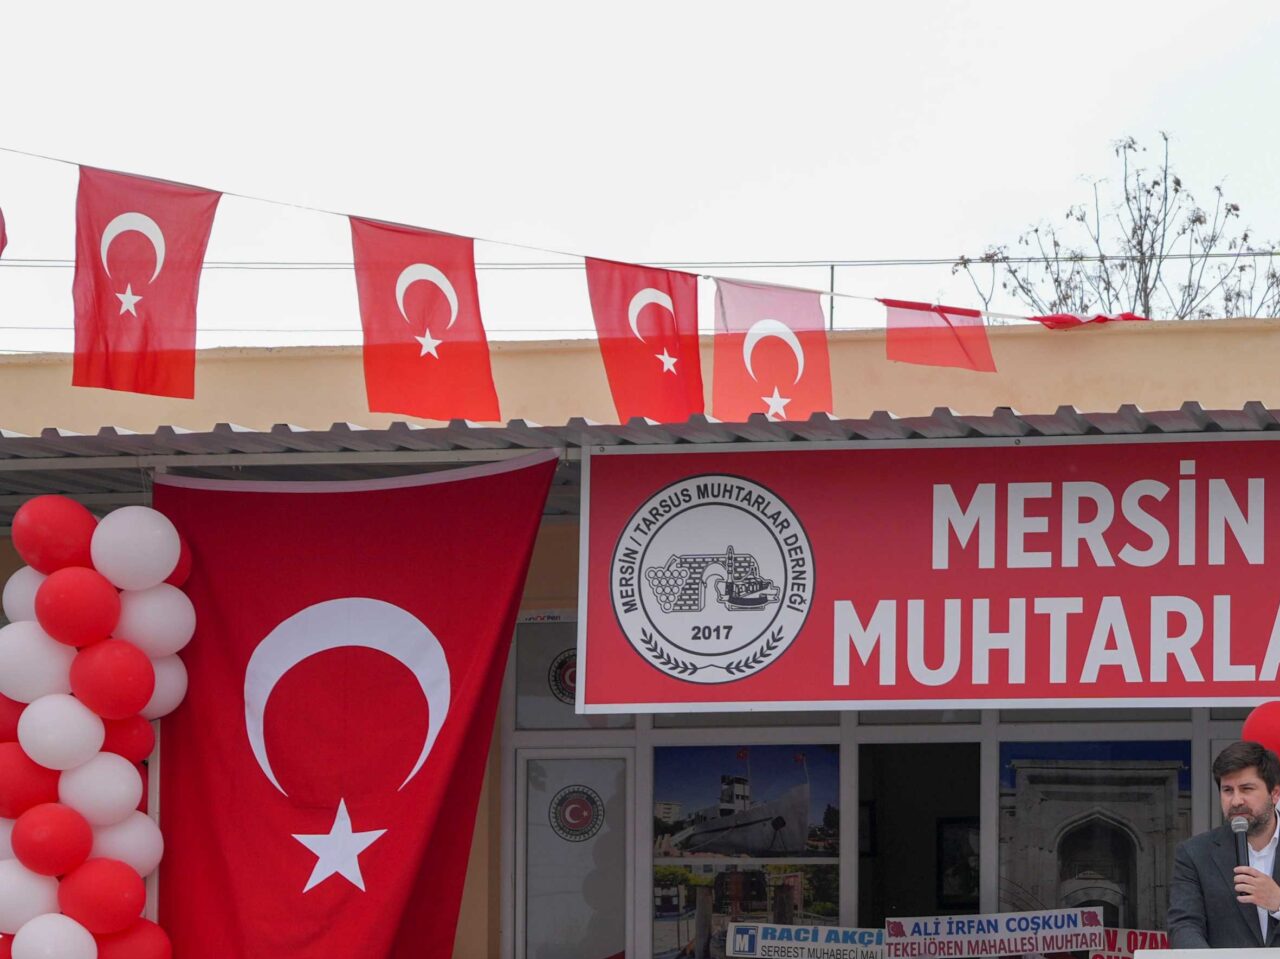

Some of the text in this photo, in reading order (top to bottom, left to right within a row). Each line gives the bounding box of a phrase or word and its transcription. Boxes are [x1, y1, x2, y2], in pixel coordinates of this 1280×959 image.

[932, 460, 1264, 569] MERSİN
[618, 547, 639, 614] MERSİN
[634, 488, 692, 536] TARSUS
[696, 483, 790, 534] MUHTARLAR
[784, 533, 807, 613] DERNEĞİ
[692, 626, 733, 641] 2017
[761, 926, 819, 943] RACİ
[911, 914, 1078, 937] ALİ İRFAN COŞKUN
[761, 945, 805, 959] SERBEST
[886, 932, 1102, 957] TEKELİÖREN MAHALLESİ MUHTARI
